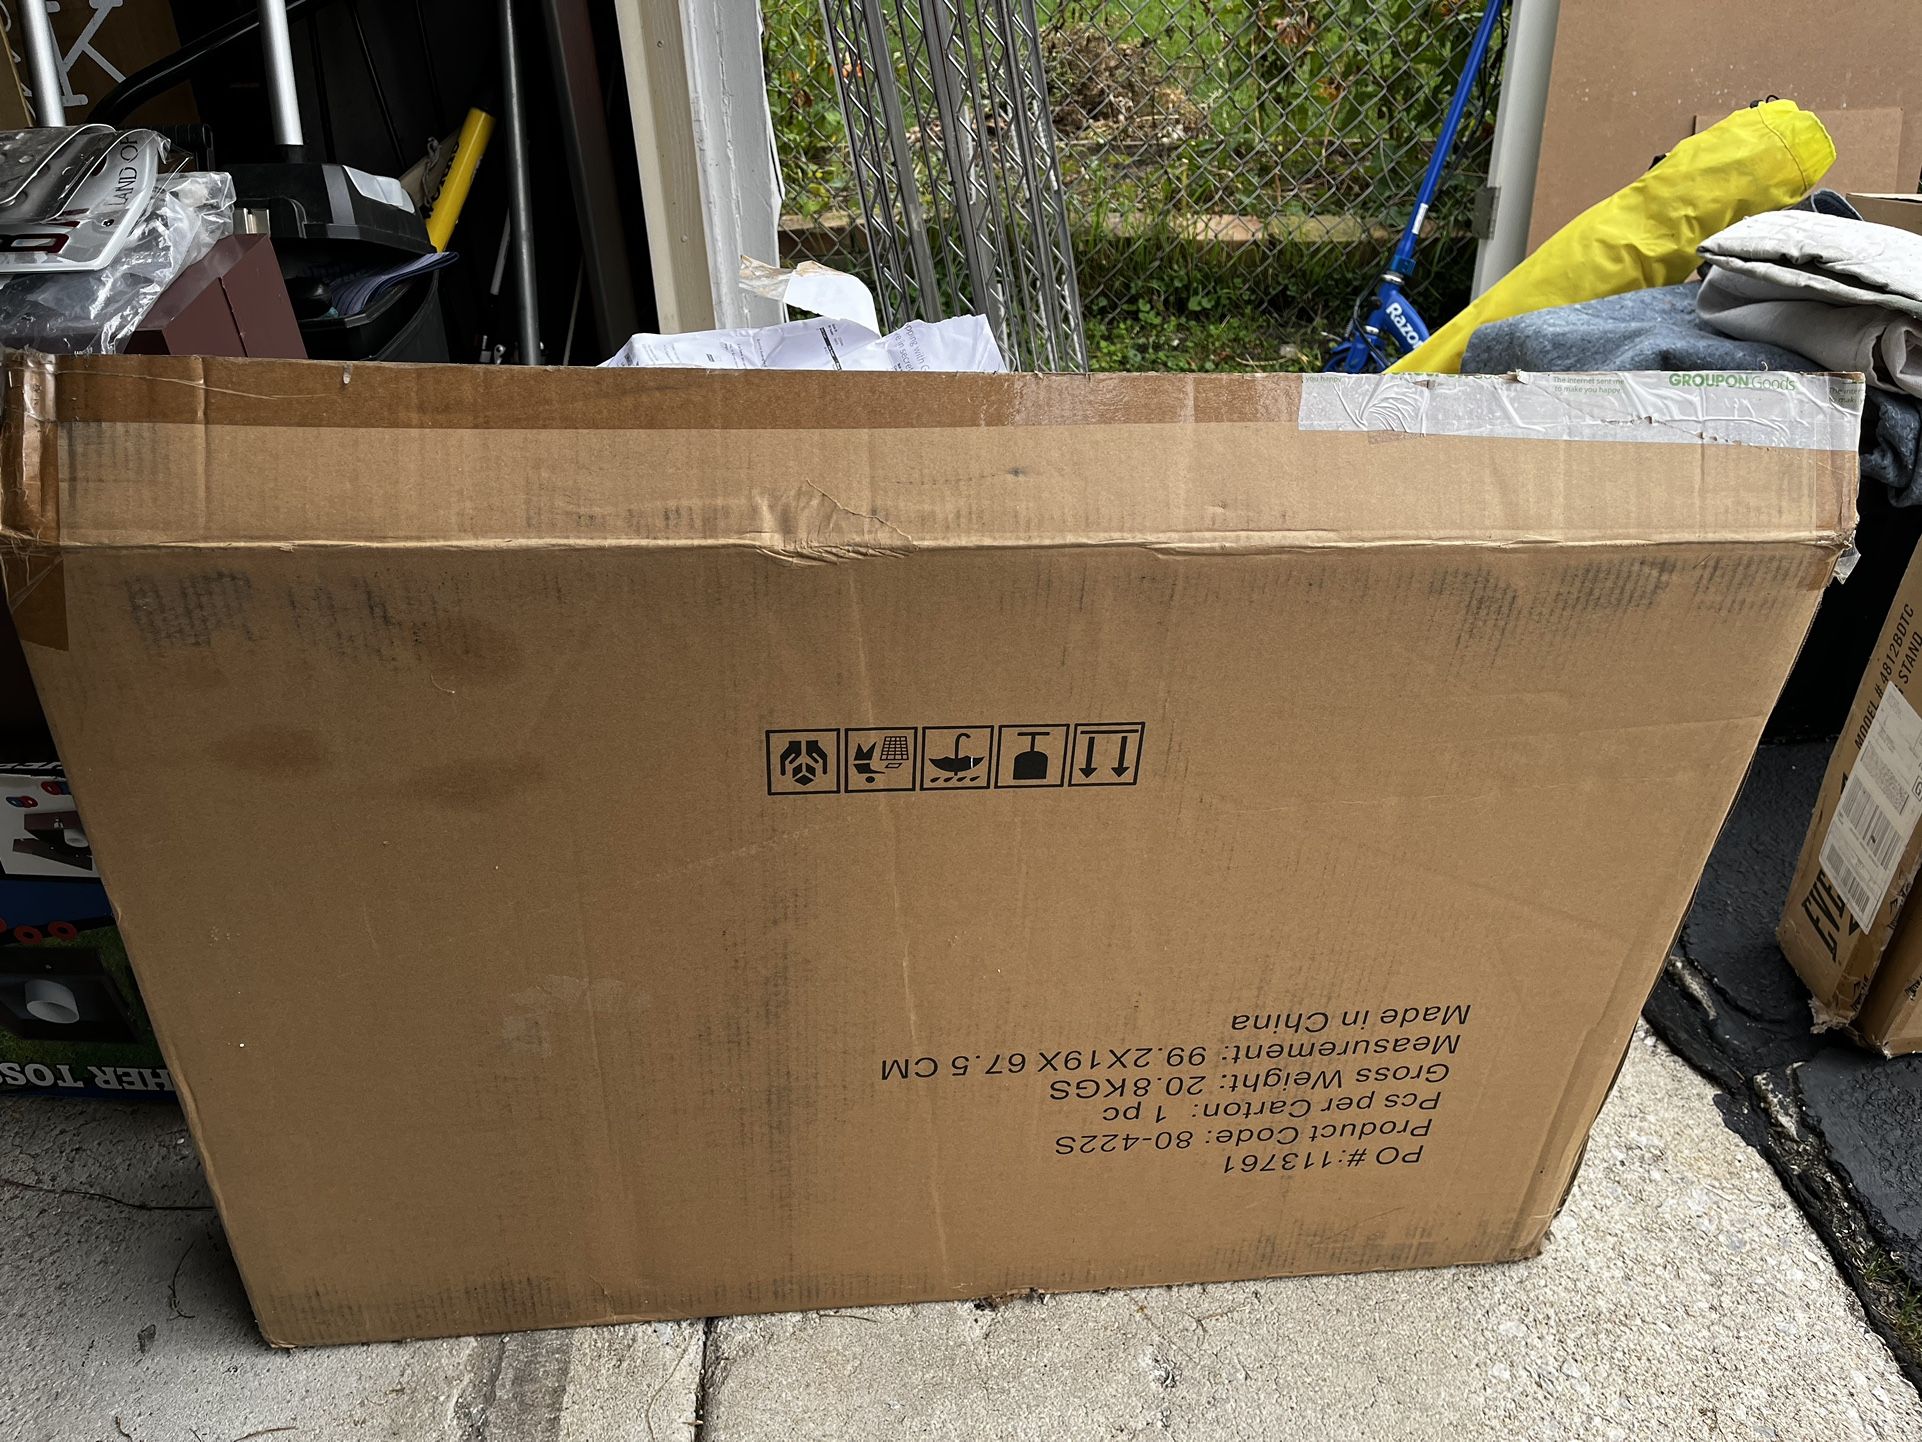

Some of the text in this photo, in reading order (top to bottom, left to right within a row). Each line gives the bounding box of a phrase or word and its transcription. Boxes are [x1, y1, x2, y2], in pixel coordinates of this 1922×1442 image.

[104, 167, 137, 206] LAND
[1668, 373, 1795, 391] GROUPON Goods
[1854, 700, 1879, 750] MODEL
[1880, 604, 1914, 684] 4812BDTC
[1232, 1005, 1470, 1033] Made in China
[882, 1035, 1460, 1080] Measurement: 99.2X19X 67.5 CM
[0, 1062, 84, 1088] TOS
[1050, 1064, 1449, 1099] Gross Weight: 20.8KGS
[1103, 1091, 1441, 1123] Pcs per Carton: 1 pc
[1056, 1119, 1432, 1154] Product Code: 80-422S
[1224, 1145, 1423, 1173] PO #:113761
